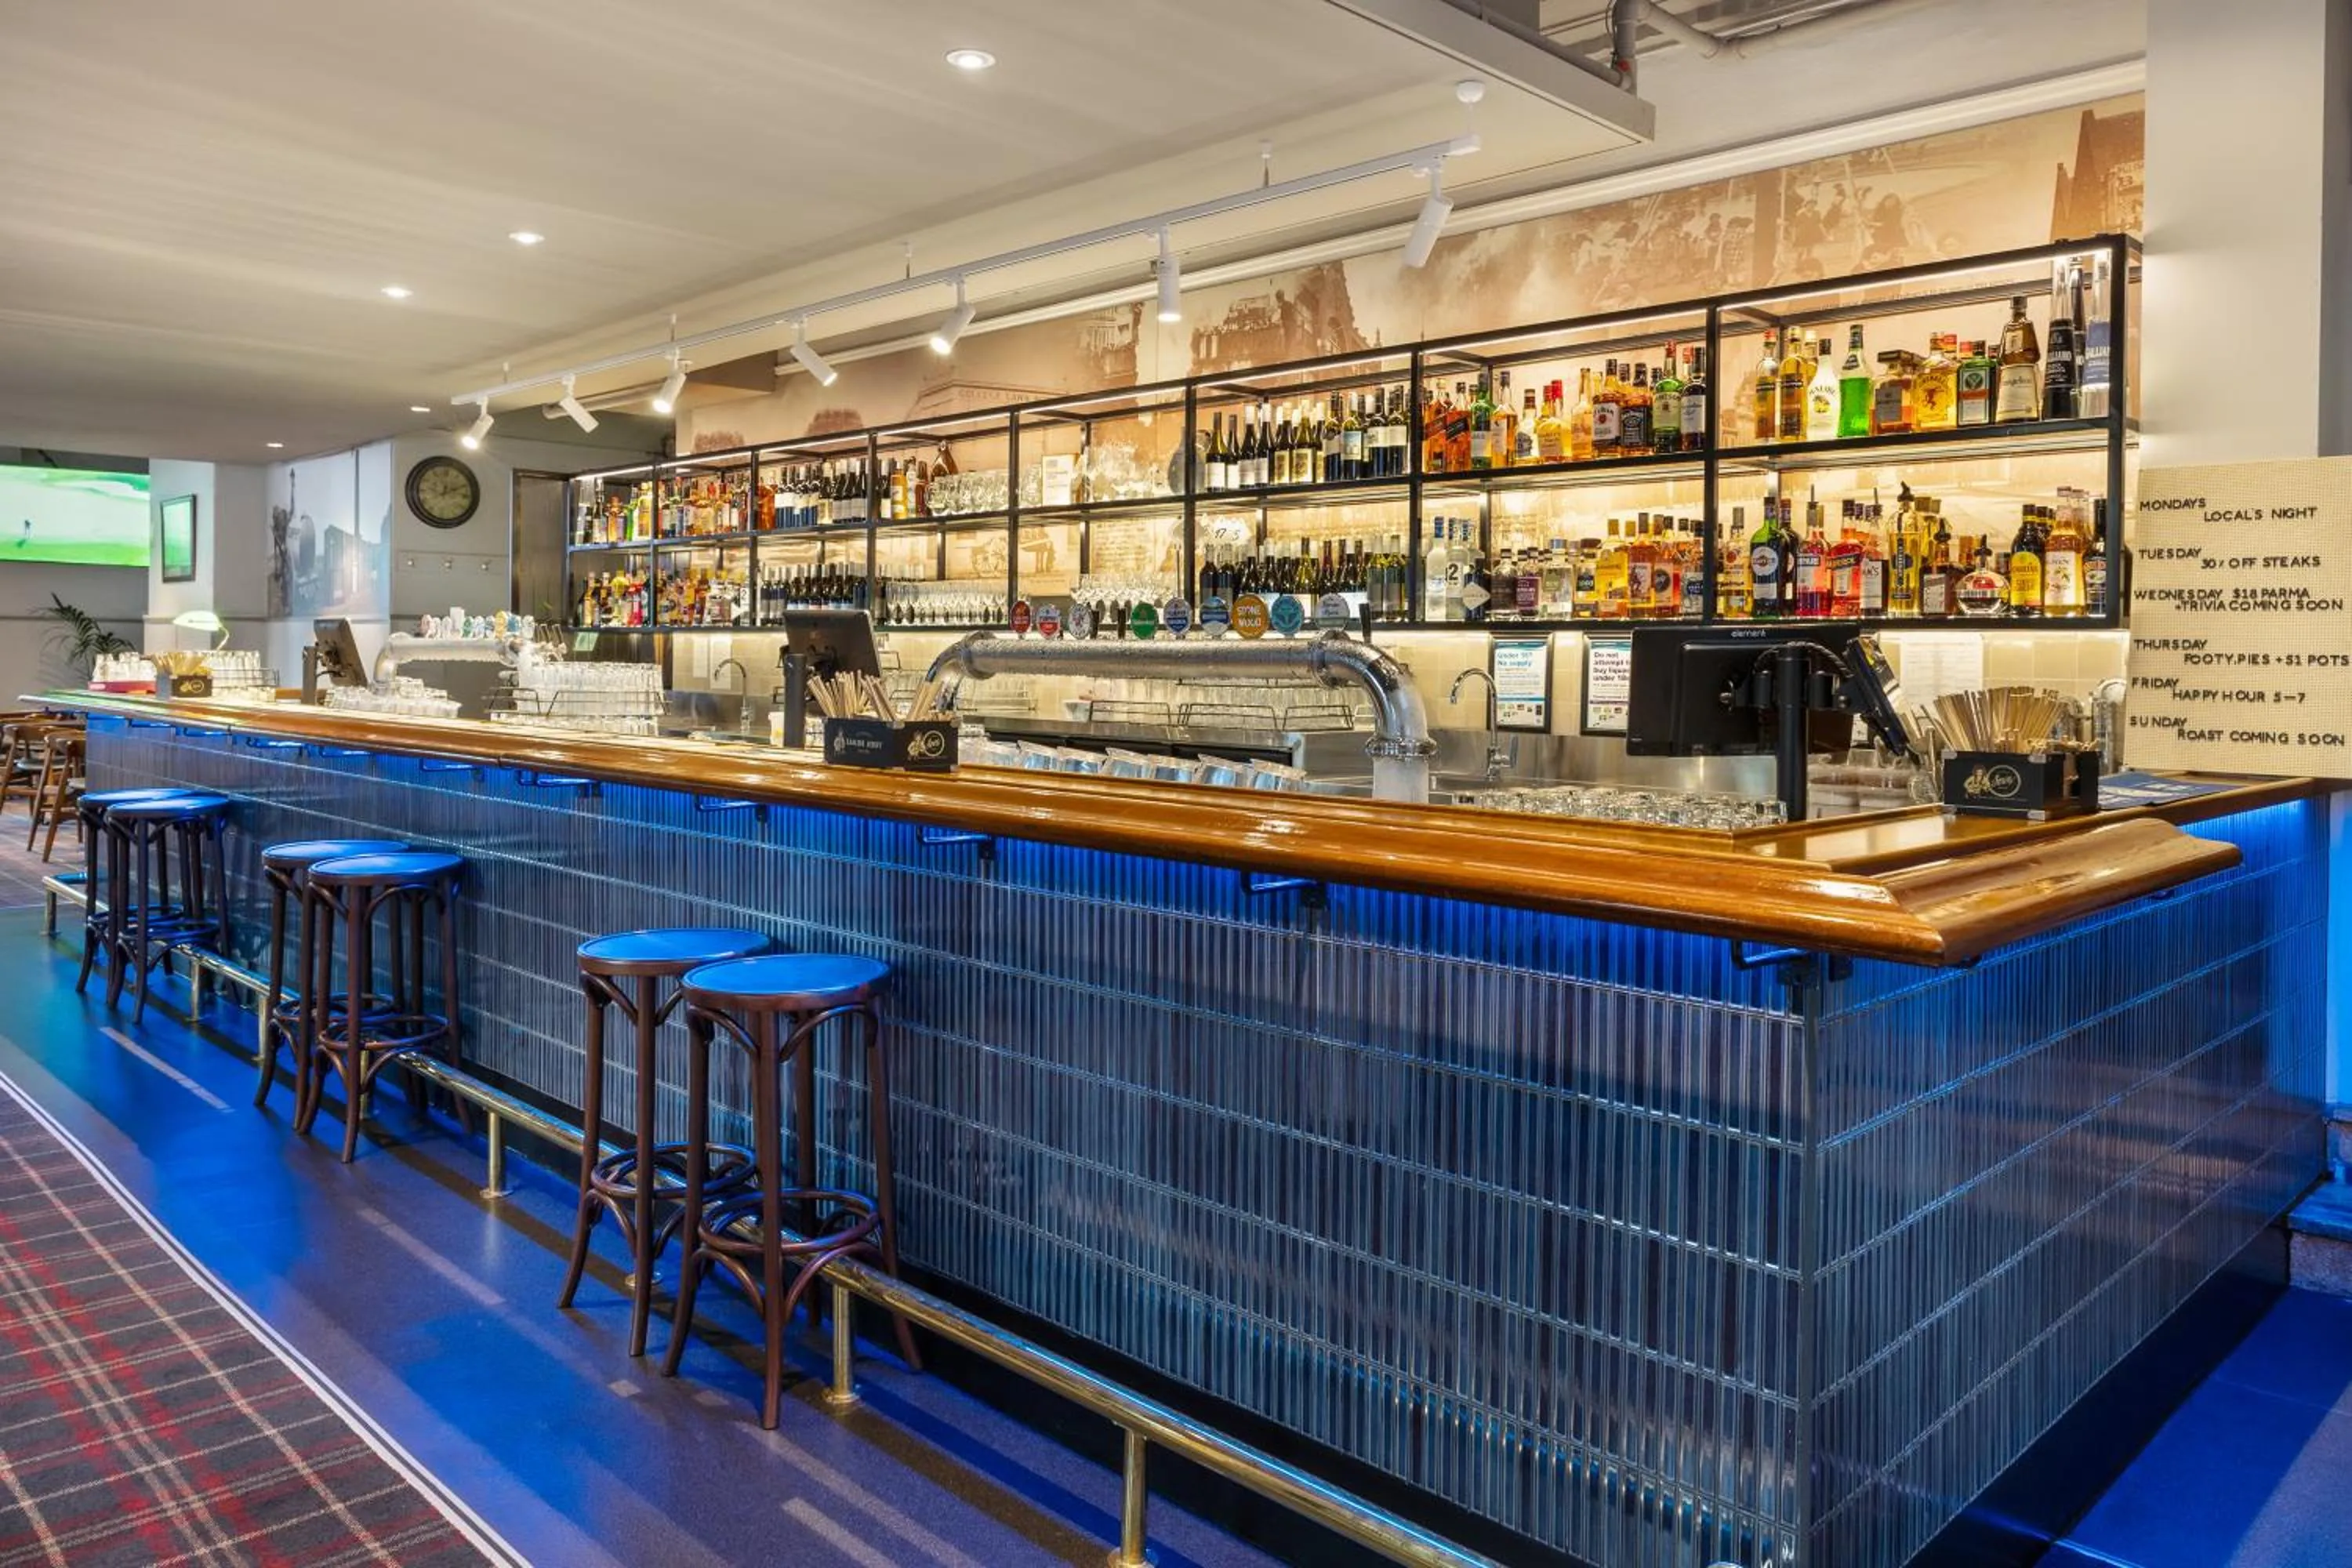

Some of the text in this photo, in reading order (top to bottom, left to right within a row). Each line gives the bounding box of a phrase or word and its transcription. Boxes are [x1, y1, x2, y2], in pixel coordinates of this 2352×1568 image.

[2271, 507, 2318, 519] NIGHT
[2139, 548, 2201, 560] TUESDAY
[2229, 557, 2256, 569] OFF
[2263, 556, 2321, 568] STEAKS
[2134, 587, 2310, 601] WEDNESDAY $18 PARMA
[2230, 600, 2292, 612] COMING
[2296, 599, 2343, 612] SOON
[2134, 639, 2208, 651] THURSDAY
[2308, 654, 2350, 666] POTS
[2132, 677, 2179, 689] FRIDAY
[2172, 689, 2219, 701] HAPPY
[2223, 690, 2265, 702] HOUR
[2130, 716, 2187, 728] SUNDAY
[2178, 728, 2345, 746] ROAST COMING SOON
